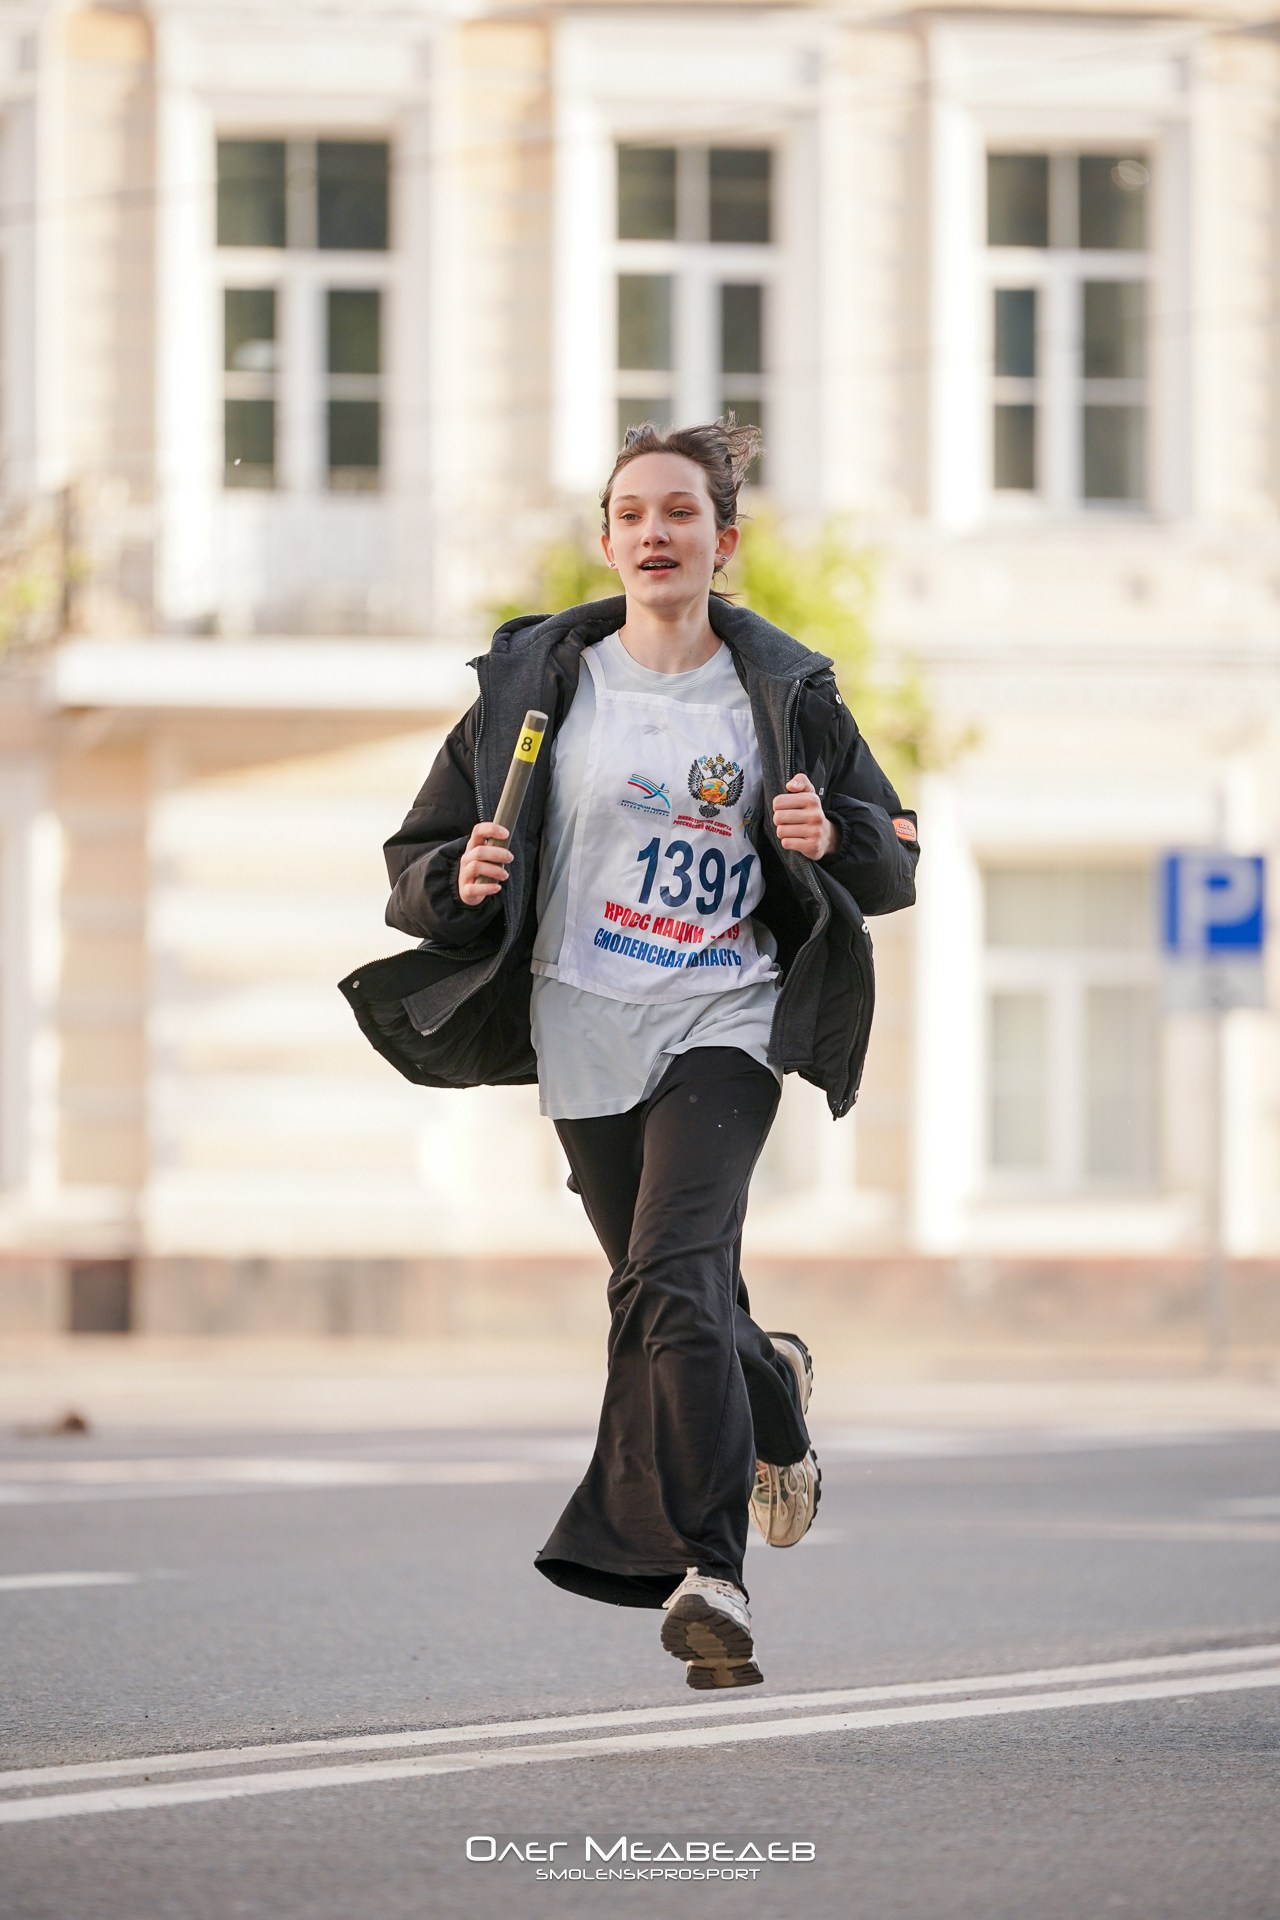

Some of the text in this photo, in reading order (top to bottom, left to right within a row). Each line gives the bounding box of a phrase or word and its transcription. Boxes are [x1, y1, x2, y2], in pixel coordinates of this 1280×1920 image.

[521, 737, 533, 751] 8
[636, 837, 757, 918] 1391
[604, 901, 651, 931] КРОСС
[652, 917, 704, 944] НАЦИИ
[594, 928, 686, 968] СМОЛЕНСКАЯ
